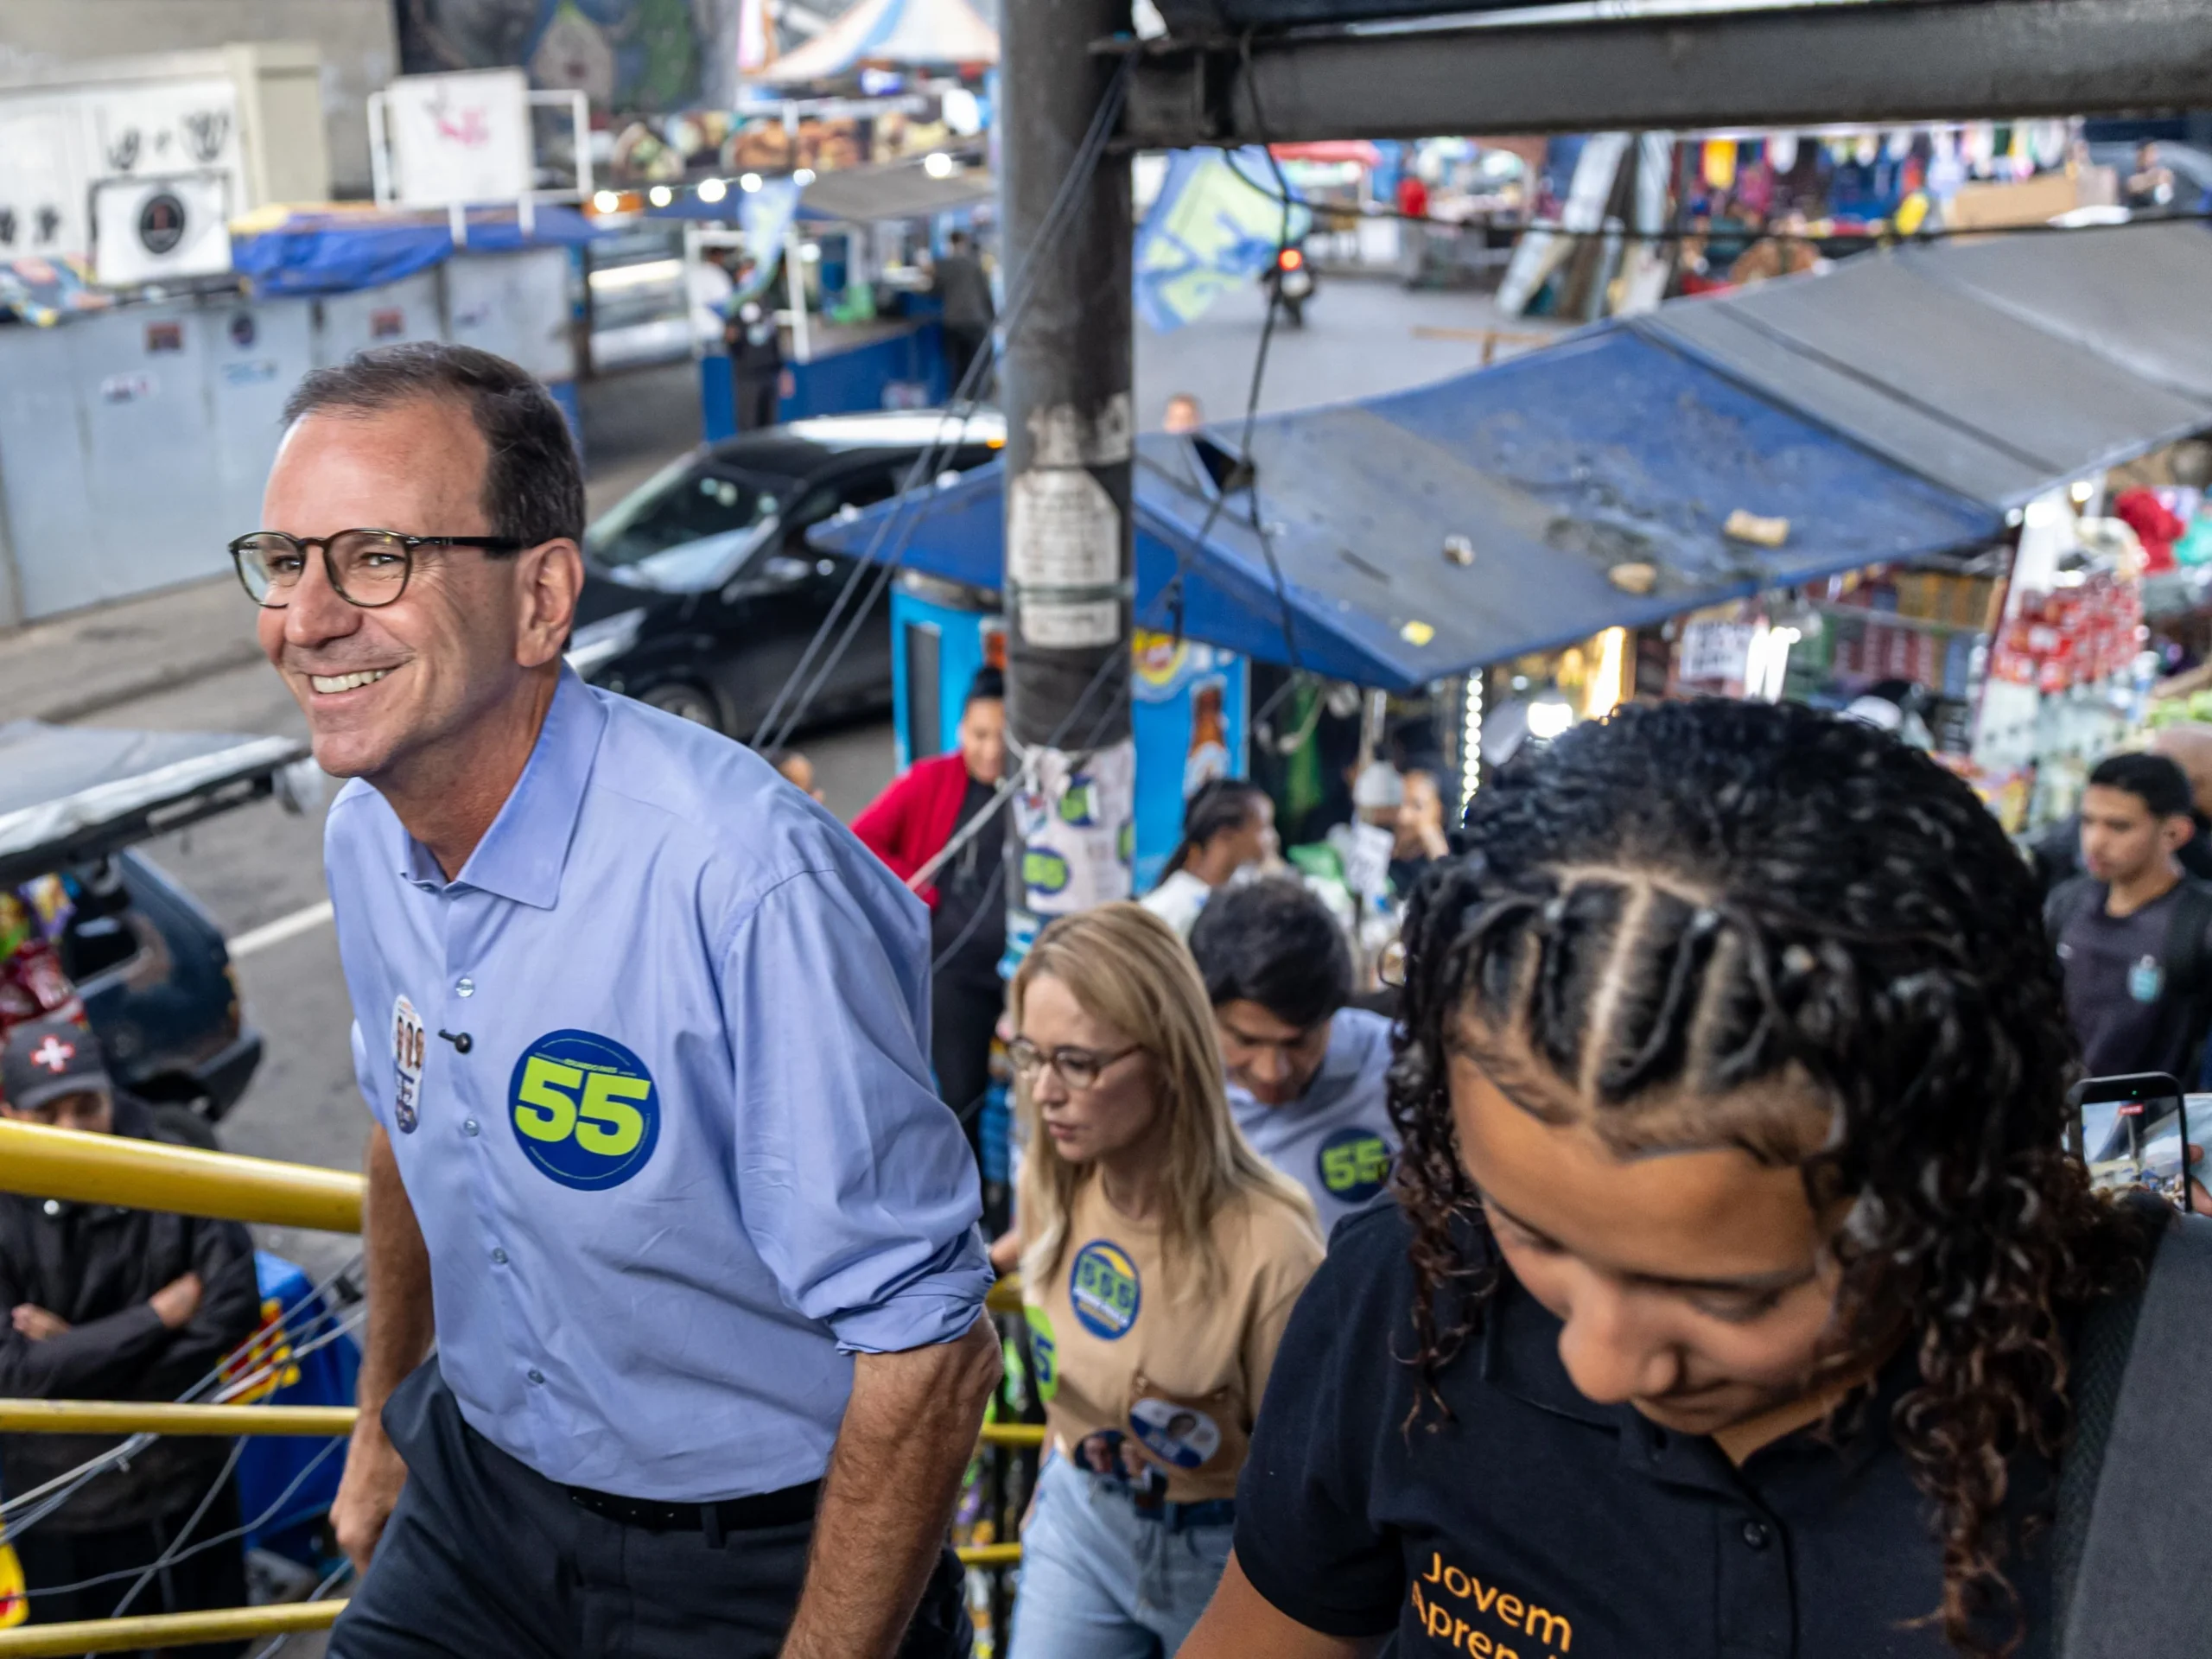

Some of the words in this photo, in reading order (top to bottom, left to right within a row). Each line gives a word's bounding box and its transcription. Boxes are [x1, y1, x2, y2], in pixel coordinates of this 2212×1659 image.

[514, 1056, 652, 1157] 55
[1320, 1136, 1389, 1191] 55
[1422, 1552, 1573, 1654] Jovem
